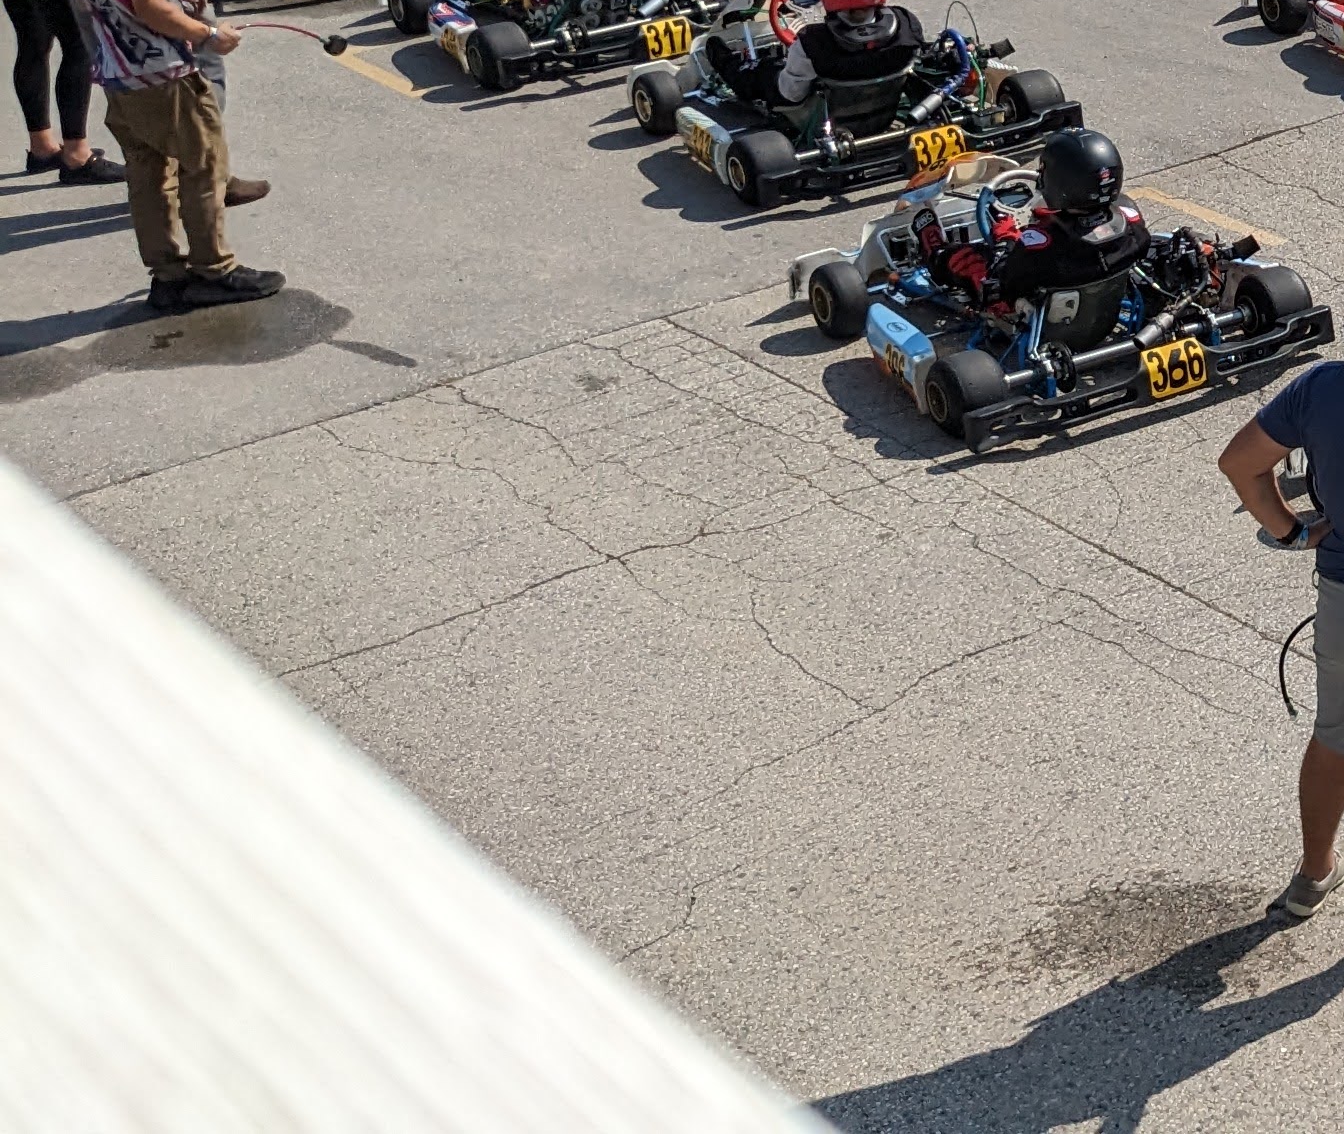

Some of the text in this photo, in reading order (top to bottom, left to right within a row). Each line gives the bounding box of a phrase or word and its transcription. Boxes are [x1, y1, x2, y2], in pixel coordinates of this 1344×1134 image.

[646, 18, 687, 58] 317
[913, 126, 966, 173] 323
[1150, 339, 1205, 393] 366
